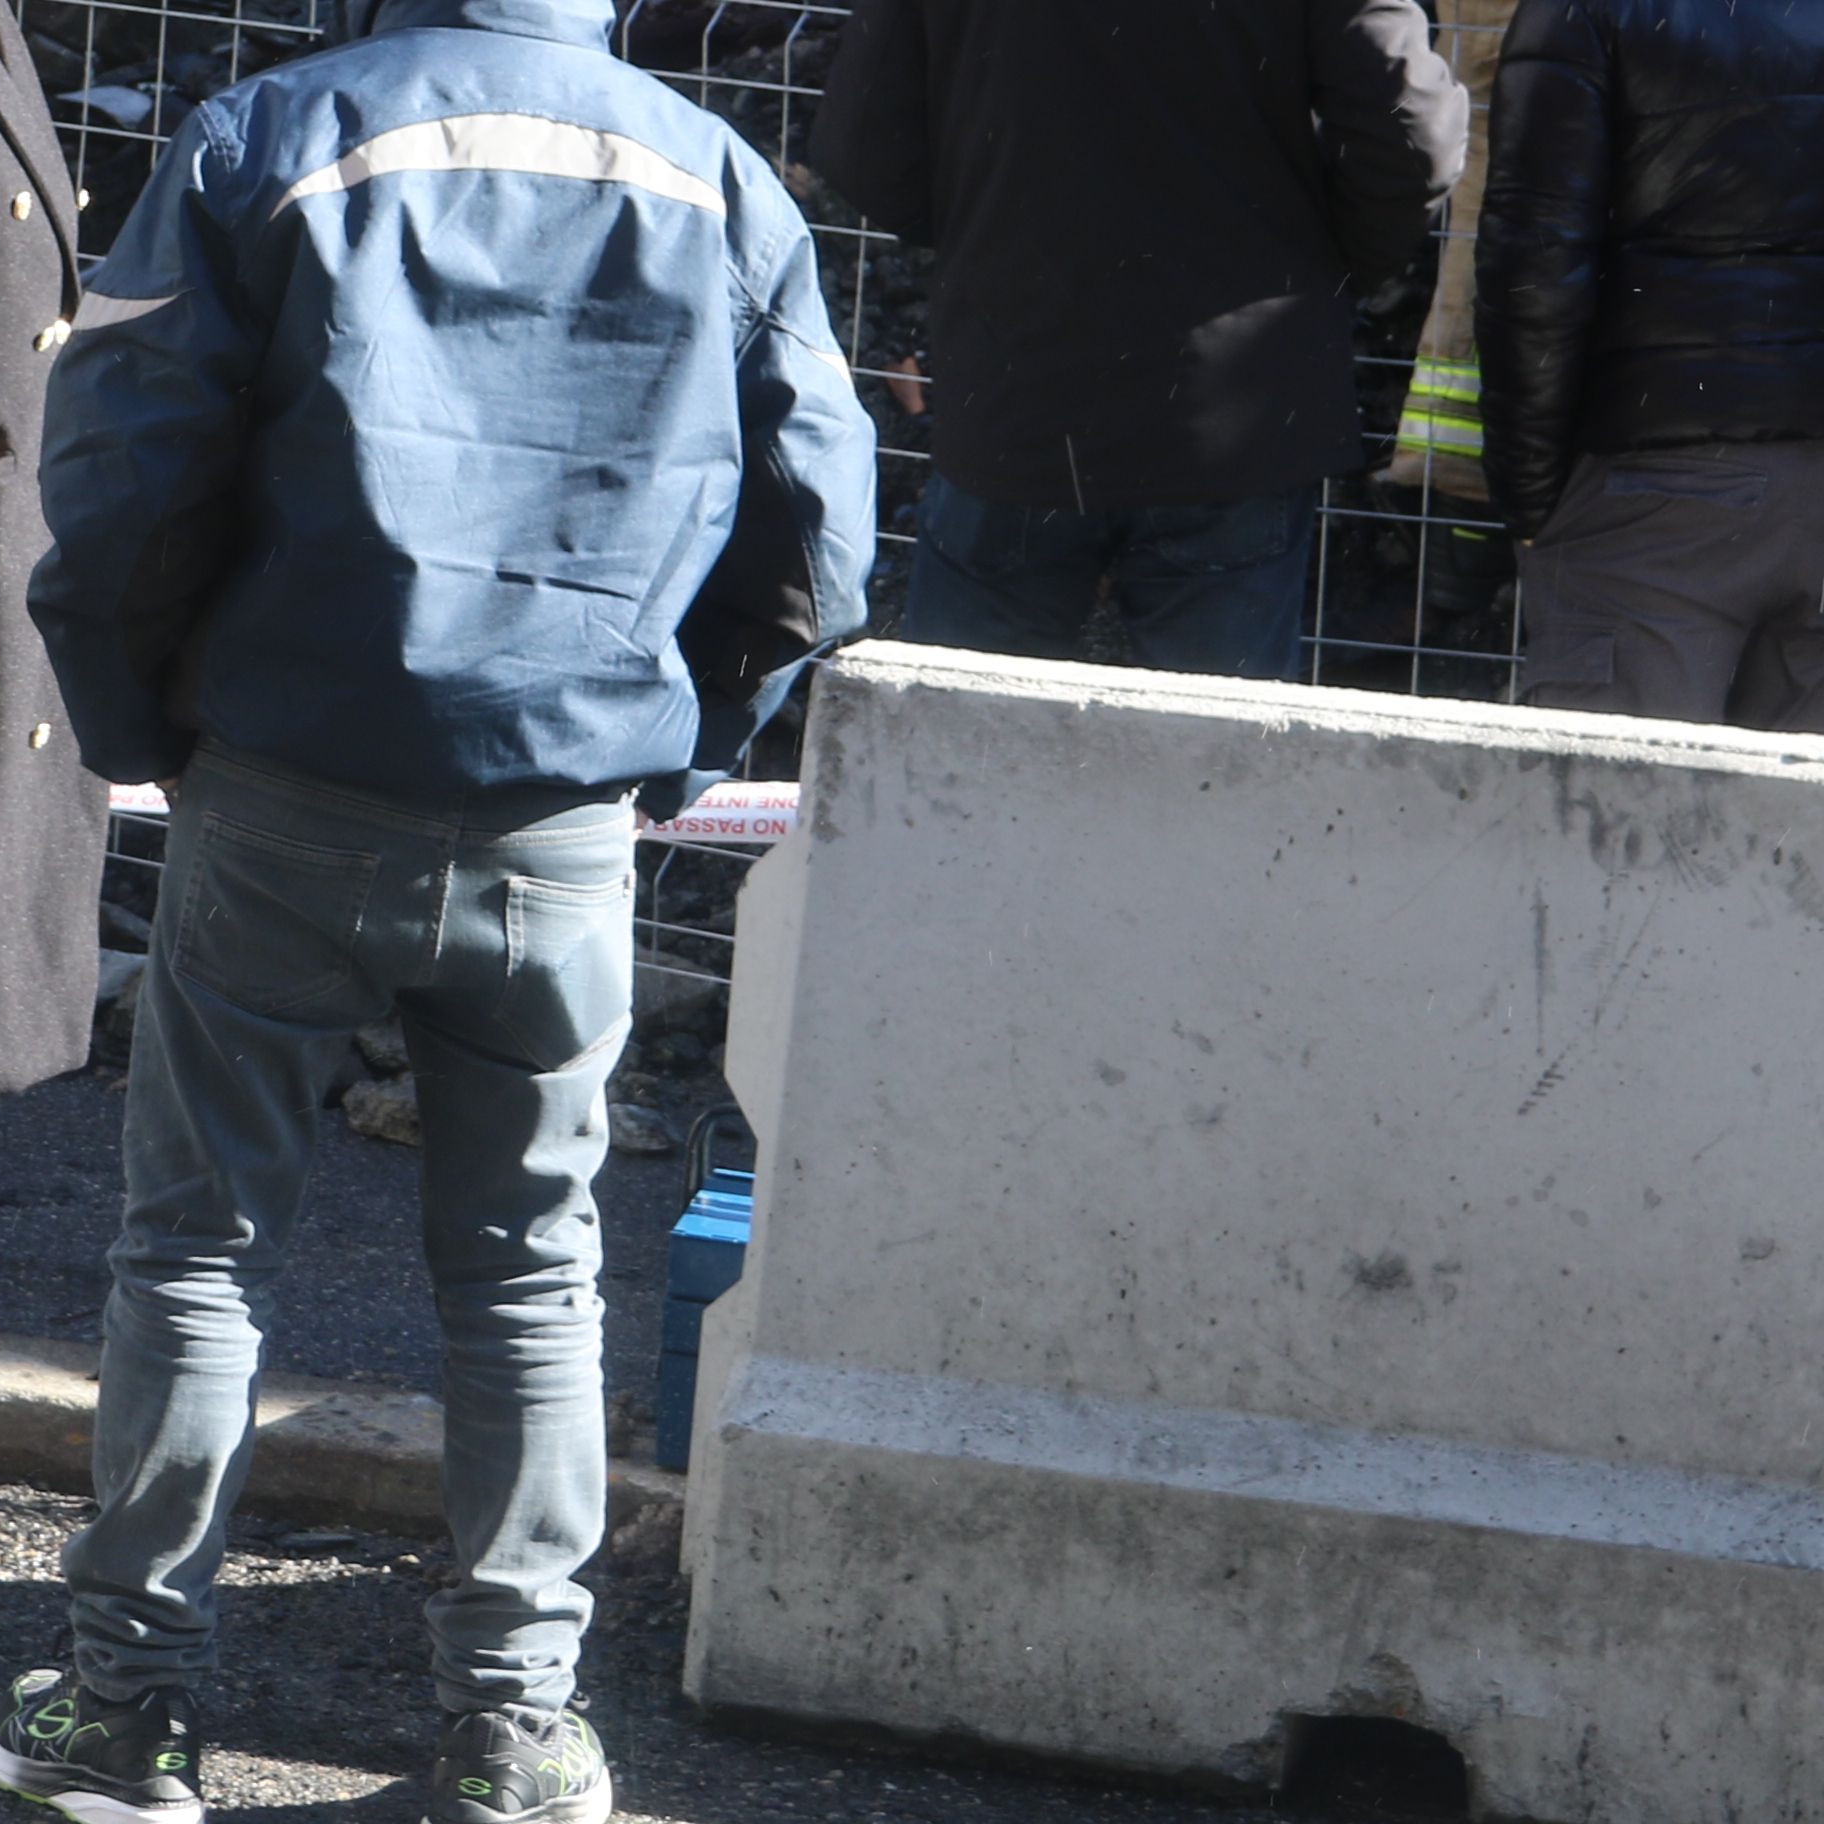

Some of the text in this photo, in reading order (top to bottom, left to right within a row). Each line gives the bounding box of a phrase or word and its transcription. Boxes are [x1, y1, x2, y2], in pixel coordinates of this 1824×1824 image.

[698, 795, 799, 808] ONE INTE
[753, 818, 787, 834] NO
